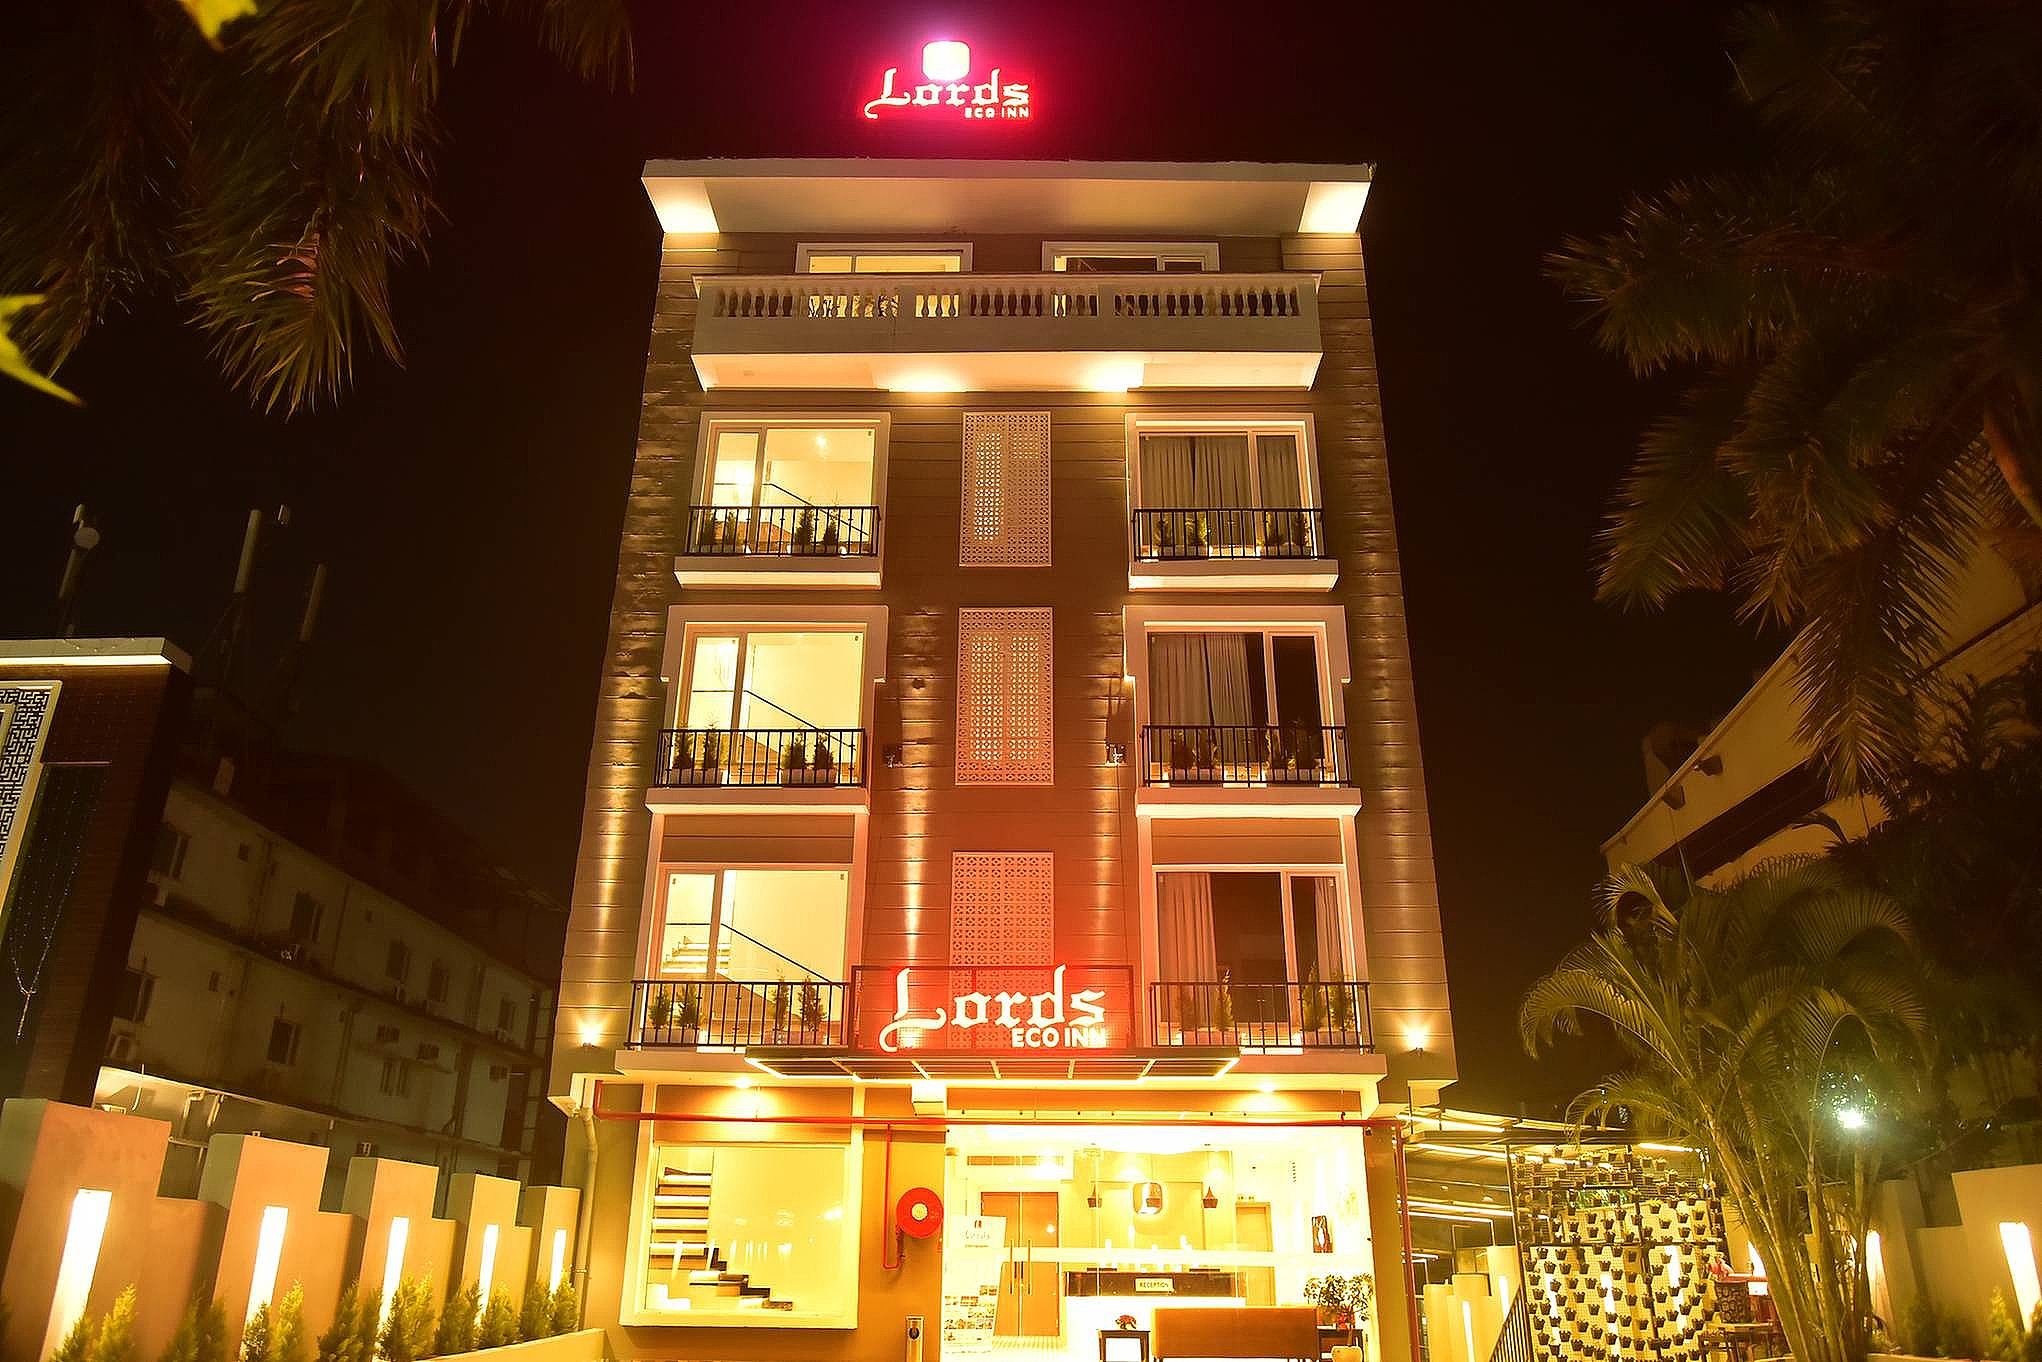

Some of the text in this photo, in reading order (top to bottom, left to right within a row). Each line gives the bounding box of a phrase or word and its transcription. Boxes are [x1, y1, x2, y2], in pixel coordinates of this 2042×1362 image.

[863, 67, 1030, 119] Lords
[965, 107, 1030, 119] ECO INN
[878, 963, 1106, 1053] Lords
[1011, 1026, 1107, 1049] ECO INN
[1139, 1280, 1170, 1289] RECEPTION
